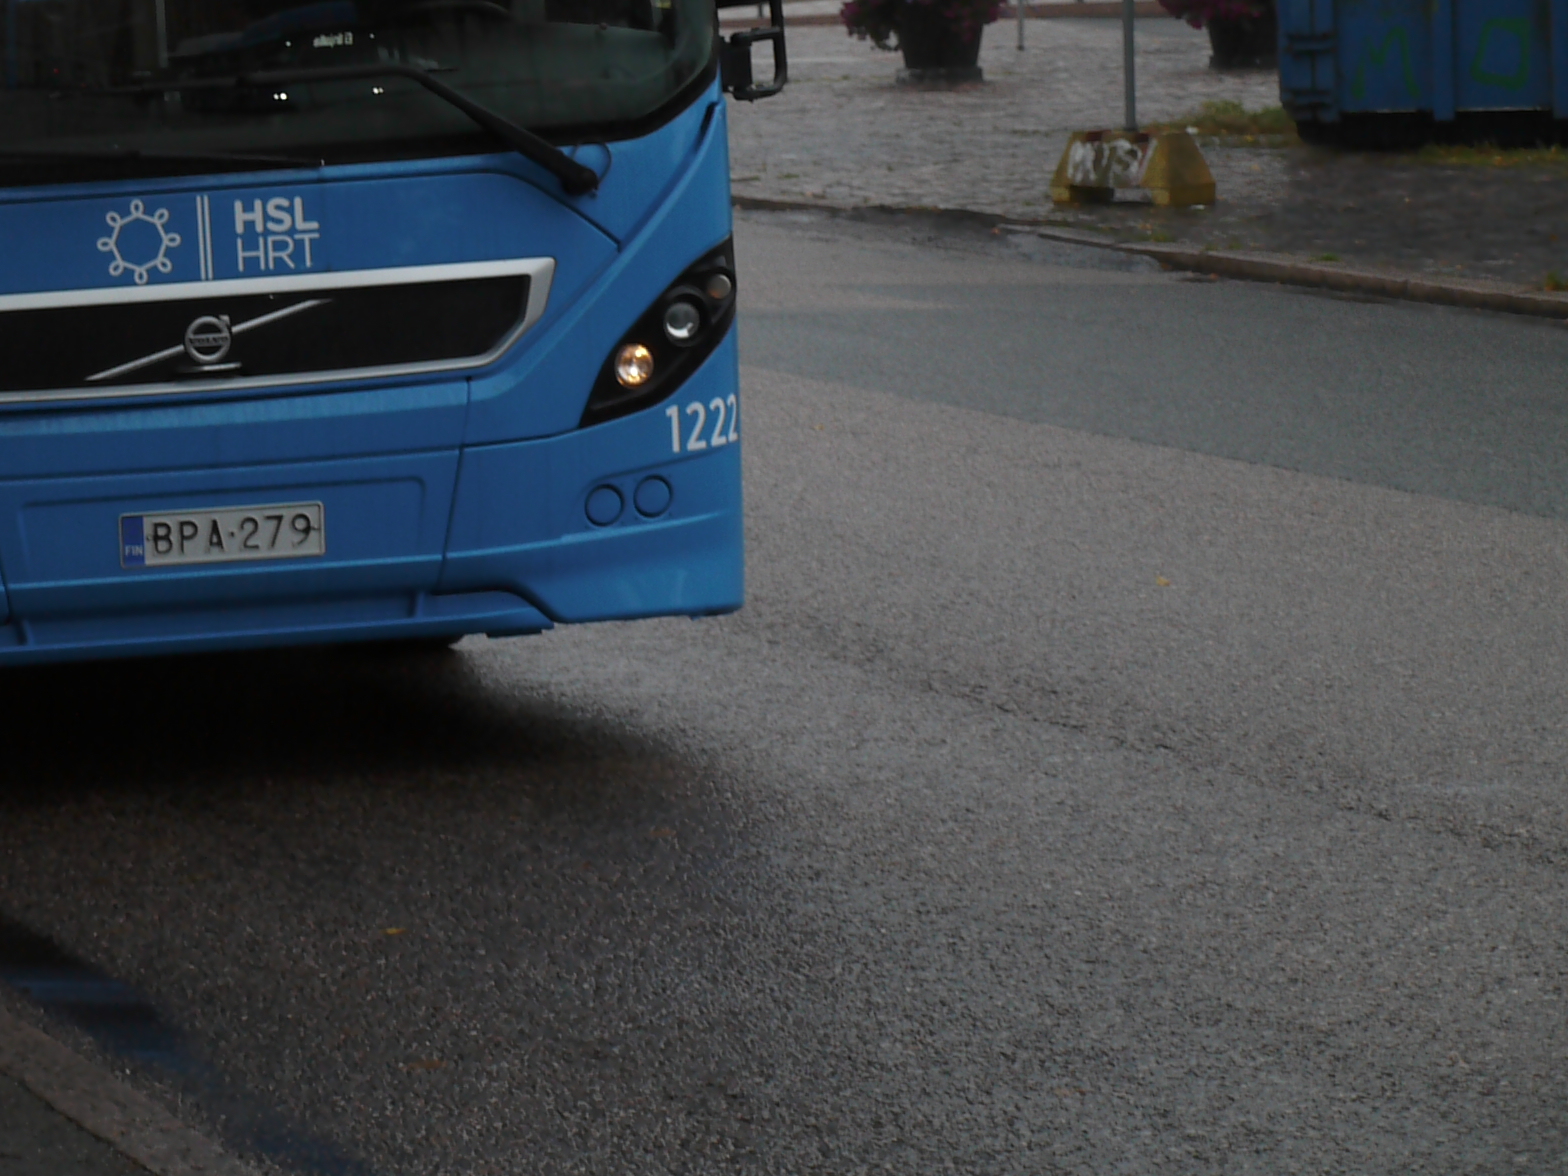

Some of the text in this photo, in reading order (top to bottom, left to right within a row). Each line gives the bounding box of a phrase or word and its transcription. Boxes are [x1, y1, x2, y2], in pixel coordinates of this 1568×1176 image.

[233, 196, 320, 235] HSL
[236, 232, 320, 272] HRT
[665, 393, 739, 453] 1222
[125, 544, 143, 557] FIN
